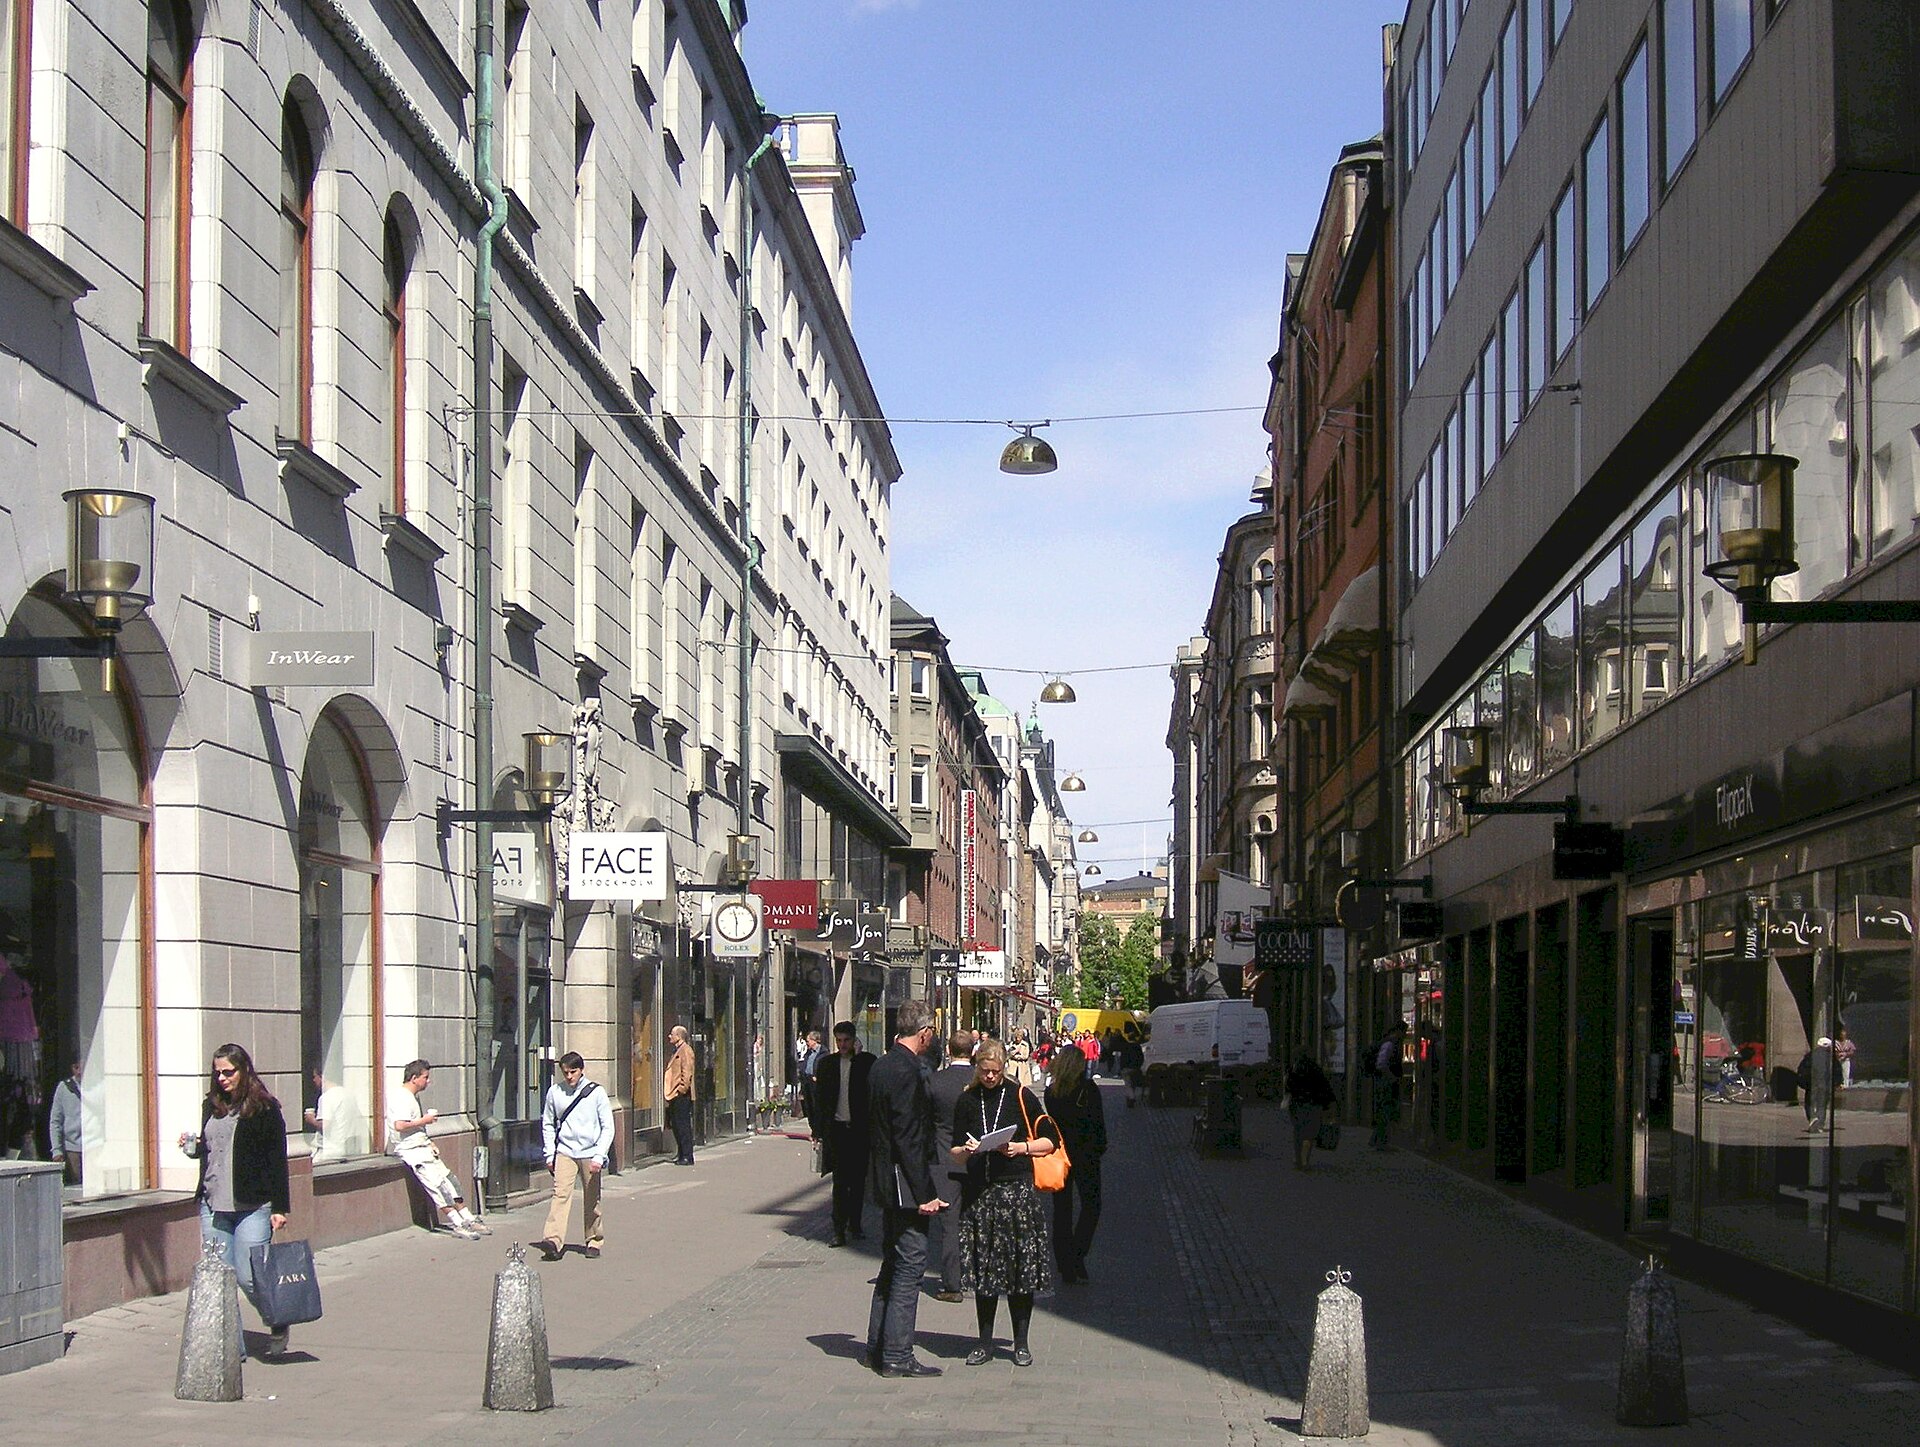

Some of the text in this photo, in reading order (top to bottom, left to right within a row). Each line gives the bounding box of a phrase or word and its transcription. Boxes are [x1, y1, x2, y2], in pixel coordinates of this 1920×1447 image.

[266, 650, 355, 665] InWear
[1745, 774, 1754, 815] K
[582, 847, 653, 874] FACE
[581, 879, 653, 887] STOCKHOLM
[724, 944, 750, 952] ROLEX
[277, 1273, 307, 1285] ZARA
